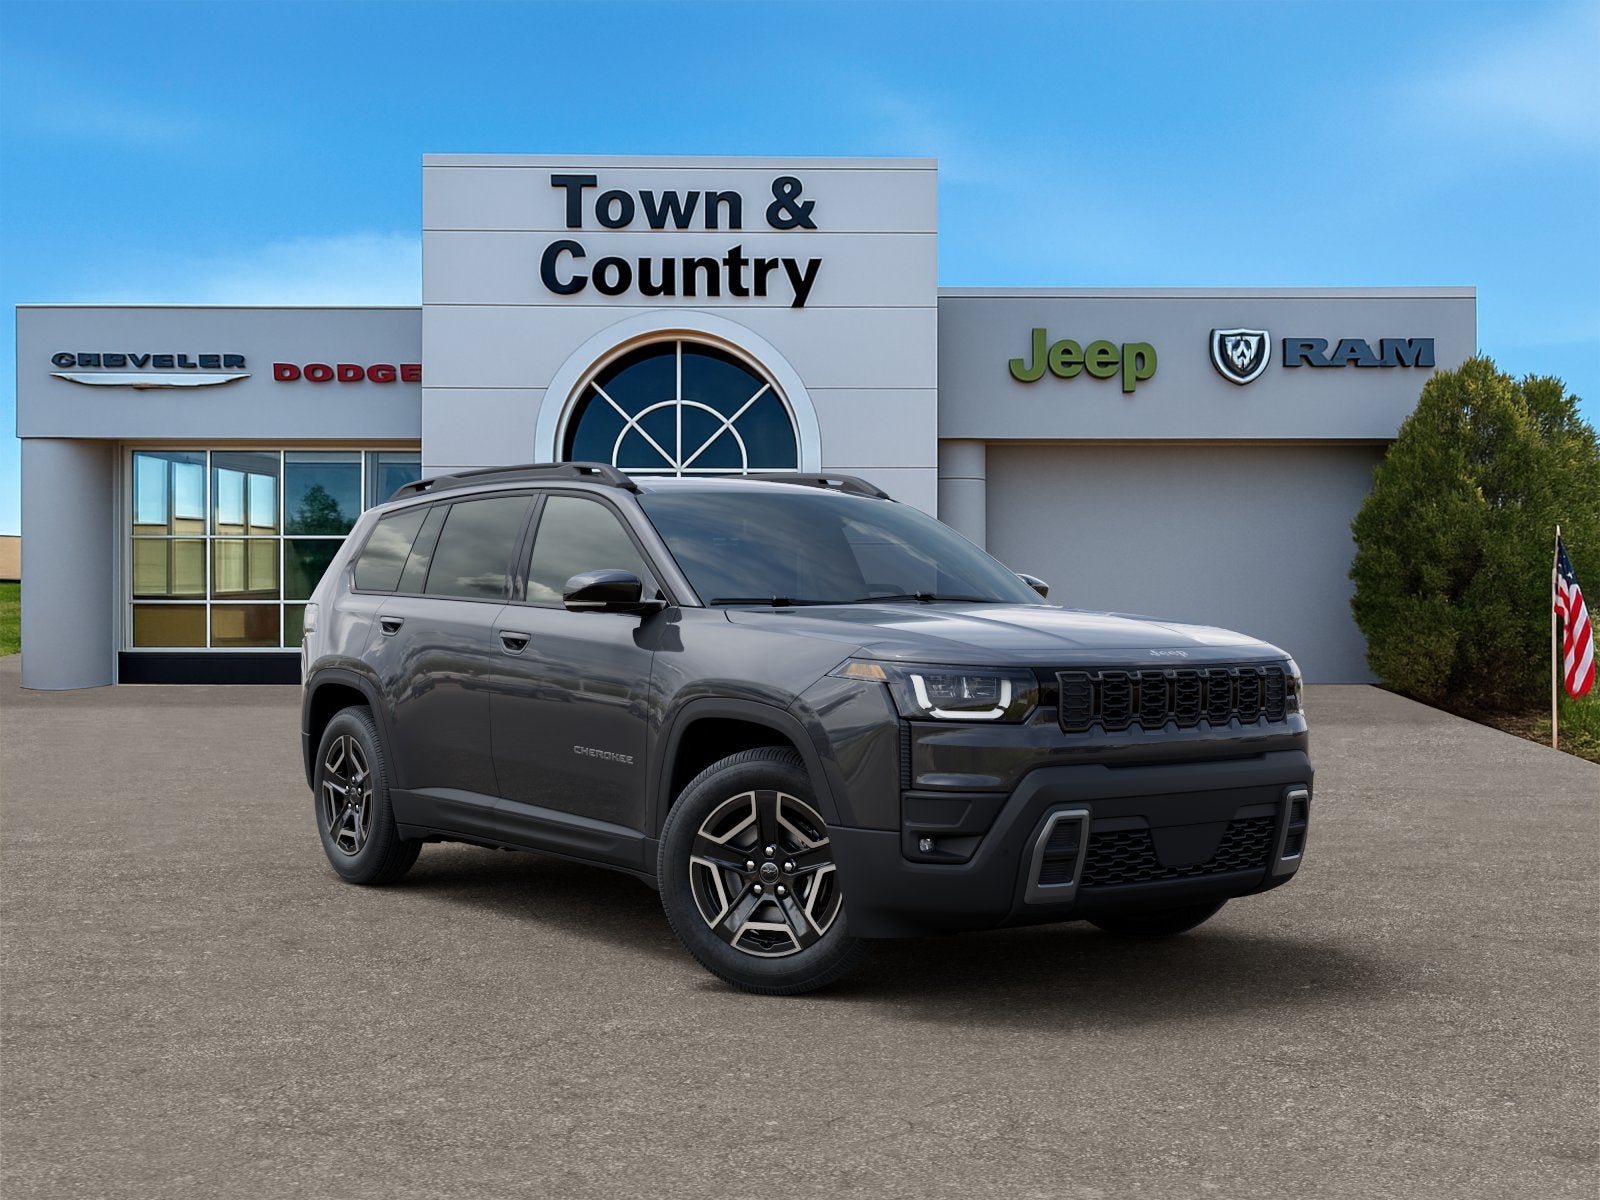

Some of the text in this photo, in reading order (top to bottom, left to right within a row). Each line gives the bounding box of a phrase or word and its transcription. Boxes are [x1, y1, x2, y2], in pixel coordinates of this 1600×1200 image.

[550, 174, 818, 229] Town &
[540, 239, 822, 308] Country
[273, 363, 422, 383] DODGE
[1009, 327, 1158, 393] Jeep
[1283, 338, 1435, 368] RAM
[573, 745, 634, 764] CHEROKEE
